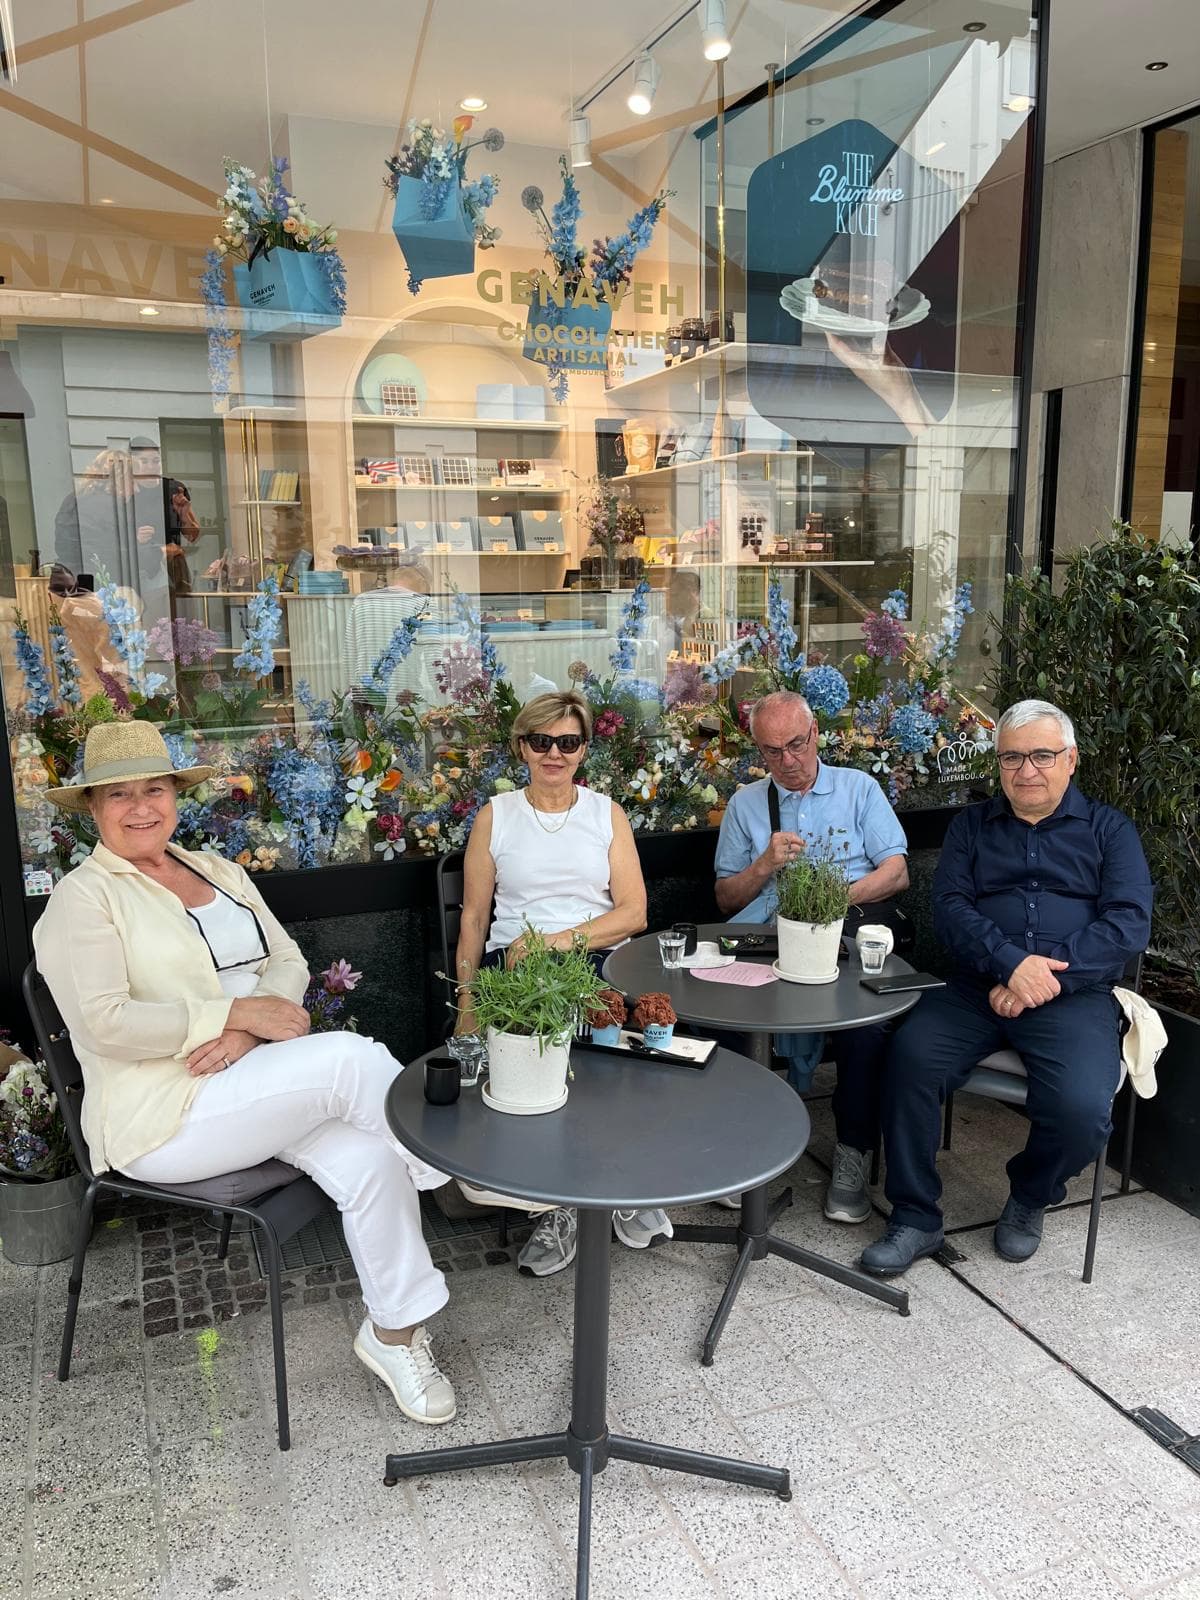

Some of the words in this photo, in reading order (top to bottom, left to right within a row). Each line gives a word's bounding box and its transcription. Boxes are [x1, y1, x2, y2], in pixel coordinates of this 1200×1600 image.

[809, 164, 904, 203] Blumme
[842, 151, 874, 188] THE
[835, 202, 880, 237] KUCH
[0, 231, 238, 302] NAVE
[476, 269, 684, 316] GENAVEH
[497, 321, 669, 351] CHOCOLATIER
[533, 348, 638, 367] ARTISANAL
[938, 771, 985, 783] LUXEMBOUG
